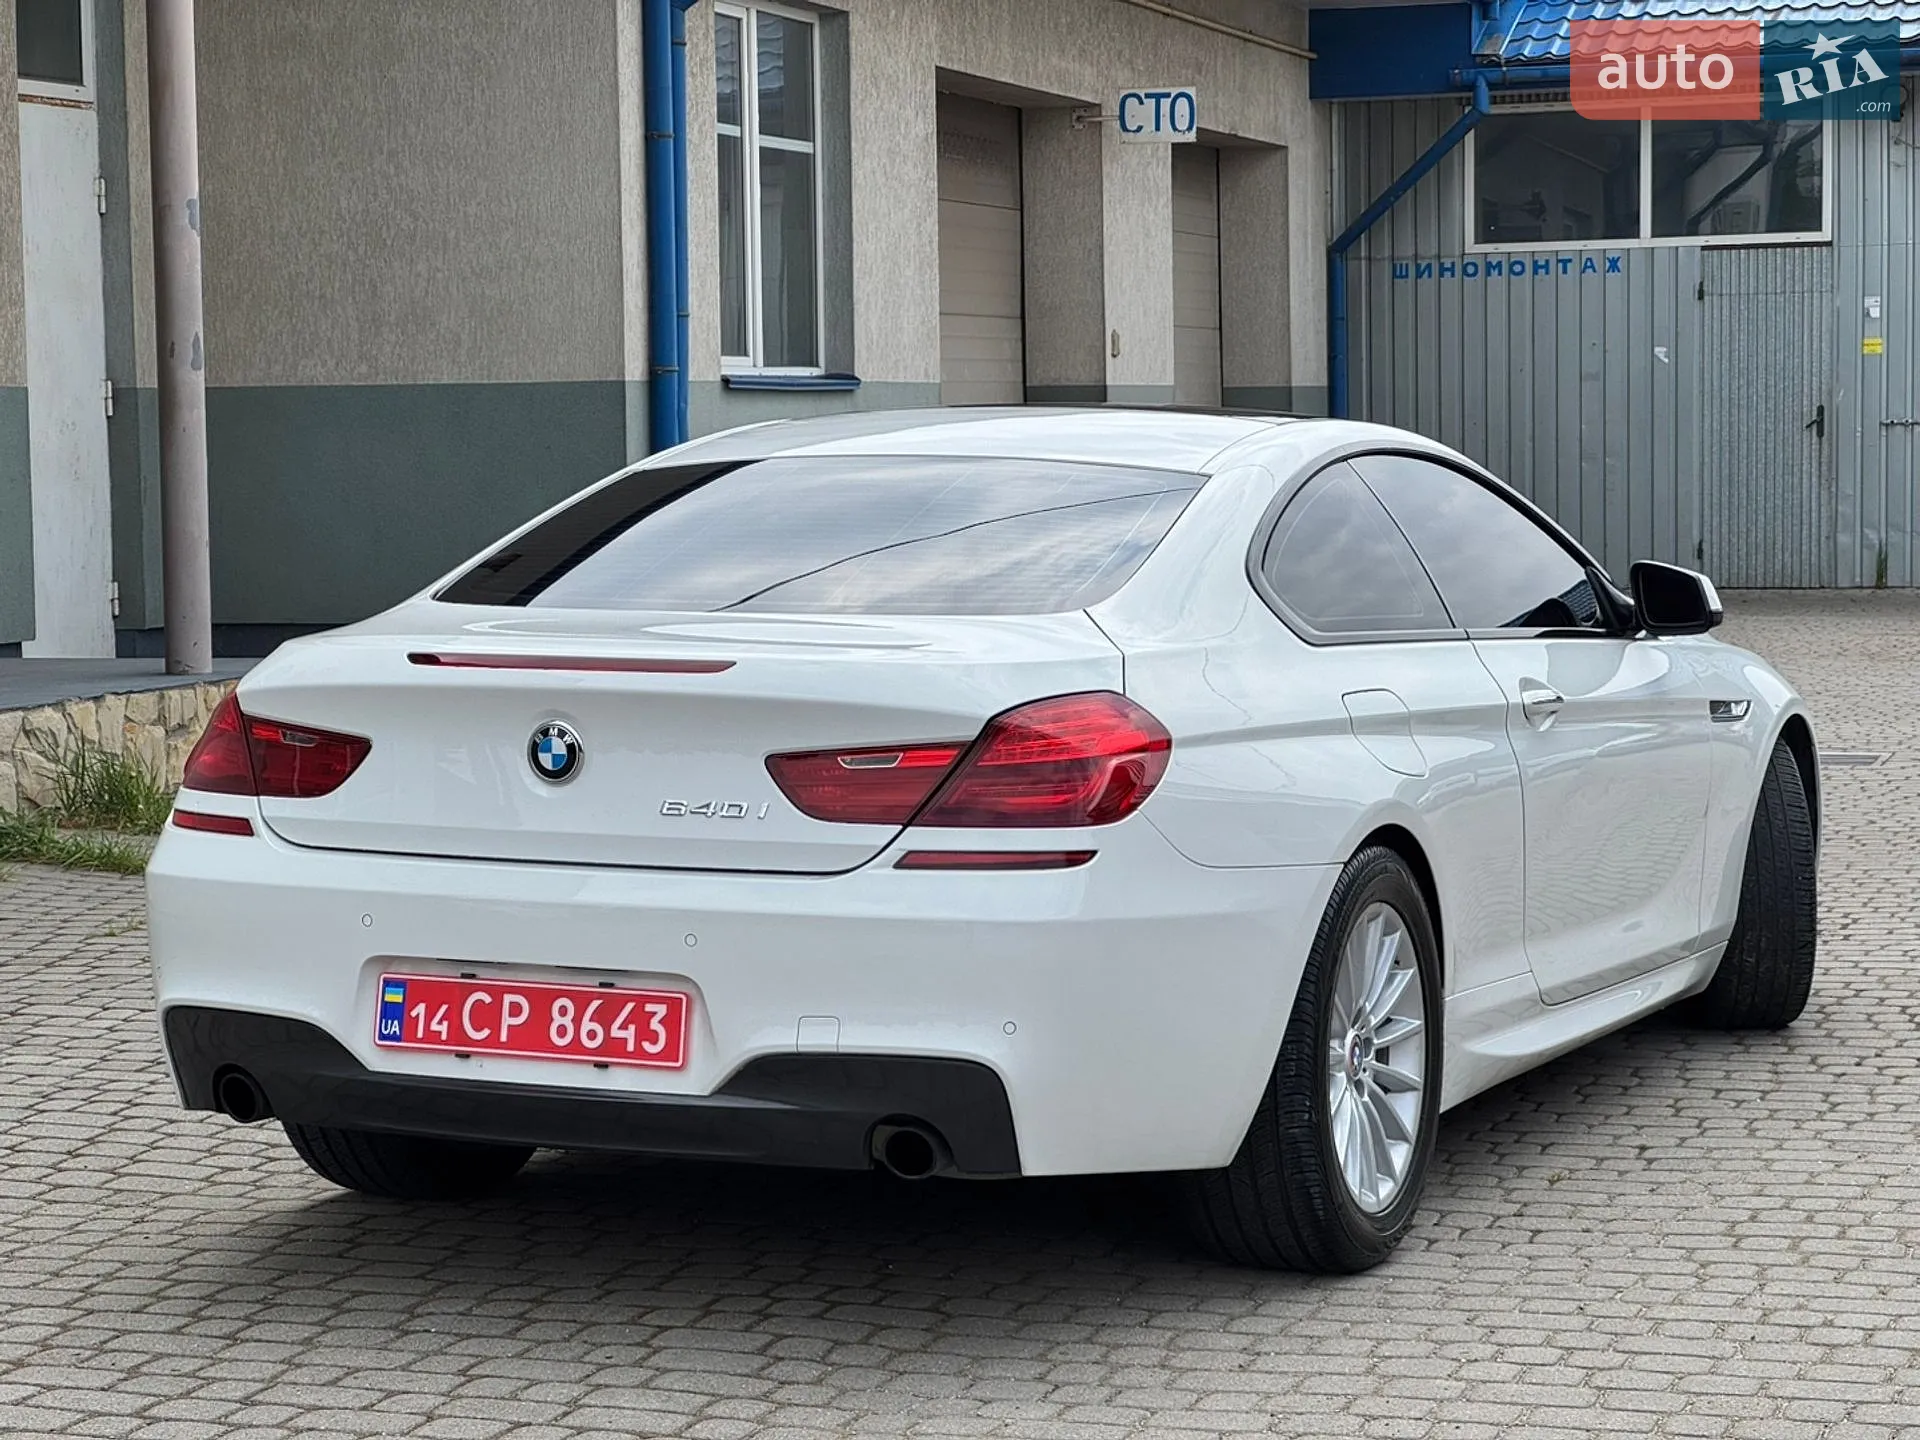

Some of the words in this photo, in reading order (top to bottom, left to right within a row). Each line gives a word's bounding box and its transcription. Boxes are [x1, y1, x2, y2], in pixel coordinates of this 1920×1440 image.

[1119, 91, 1196, 133] СТО
[1393, 255, 1622, 280] ШИНОМОНТАЖ
[534, 726, 574, 745] BMW
[381, 1018, 401, 1036] UA
[548, 996, 669, 1055] 8643
